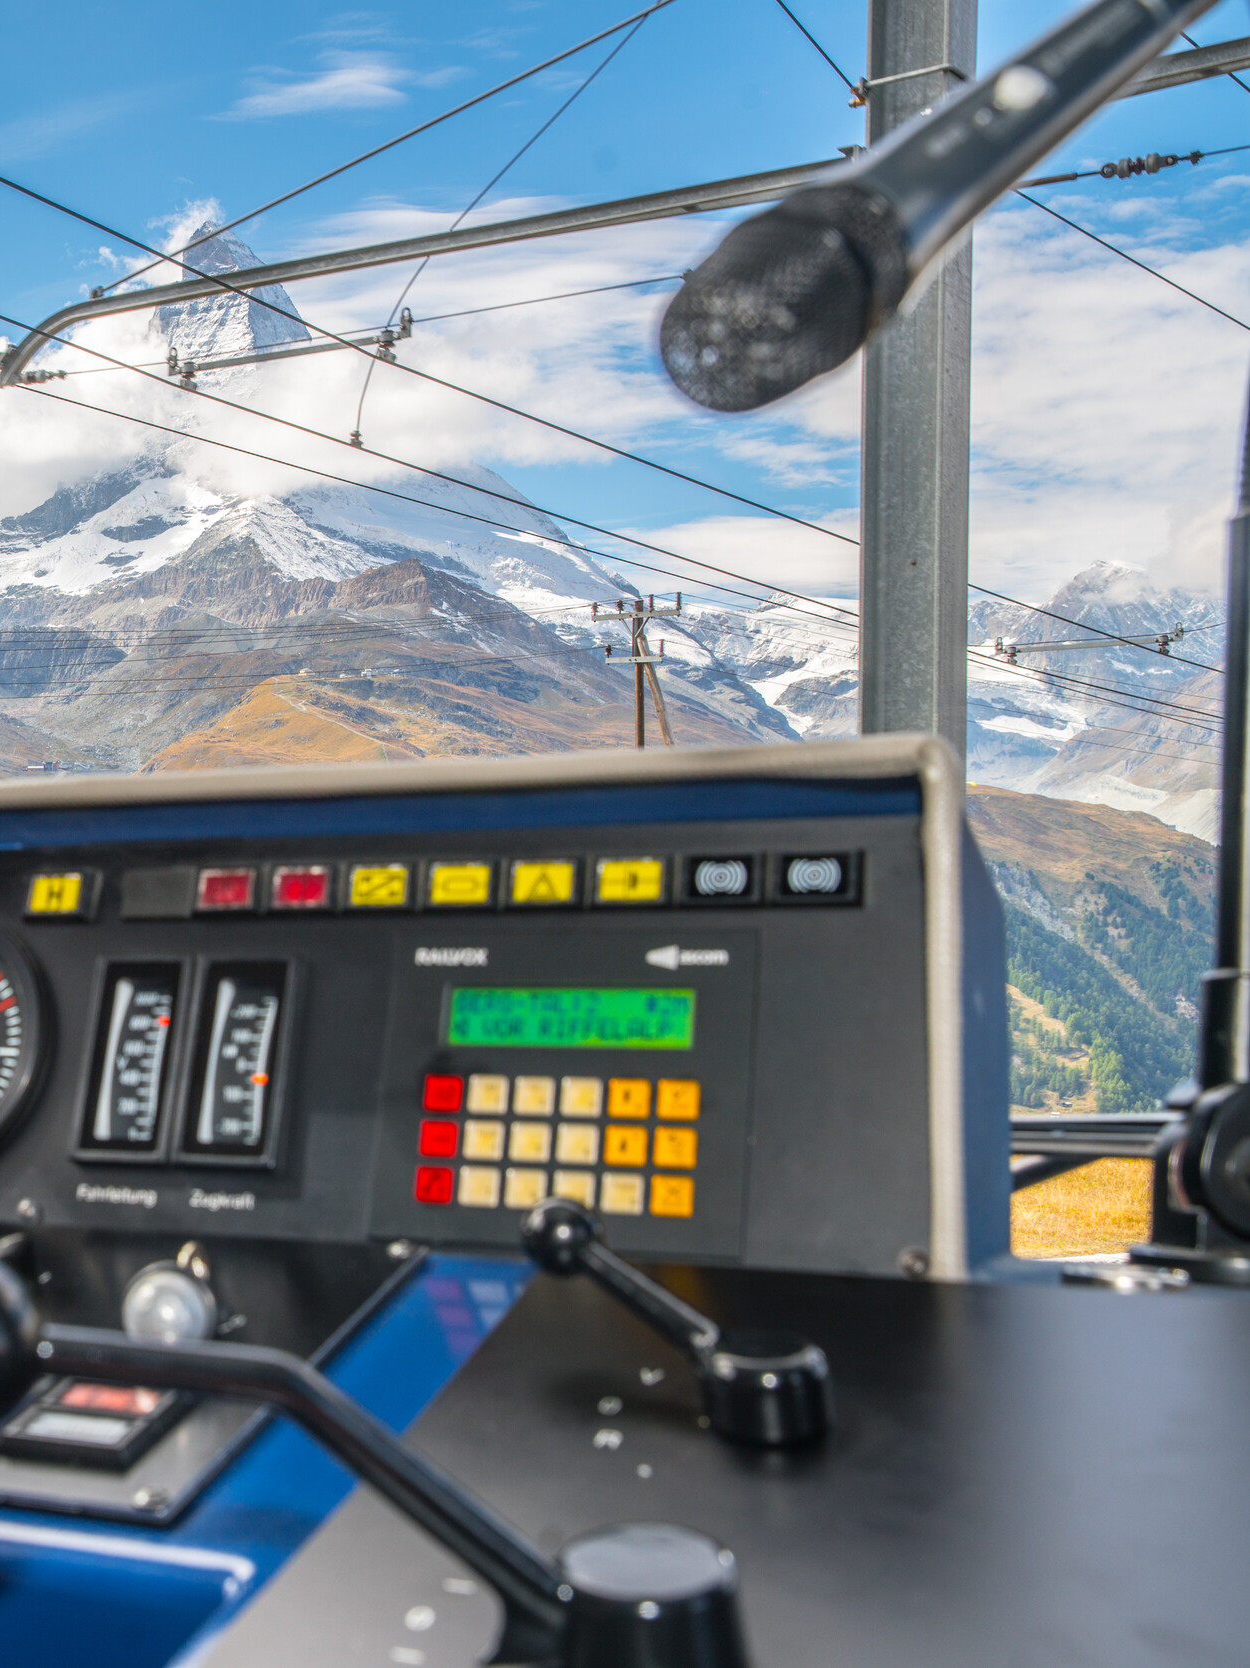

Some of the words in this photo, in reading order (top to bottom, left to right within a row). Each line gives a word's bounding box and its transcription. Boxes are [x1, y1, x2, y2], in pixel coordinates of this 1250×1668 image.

[414, 947, 489, 966] RAILVOX
[681, 949, 729, 967] ascom
[76, 1183, 158, 1209] Fahrleitung
[188, 1188, 256, 1212] Zugkraft
